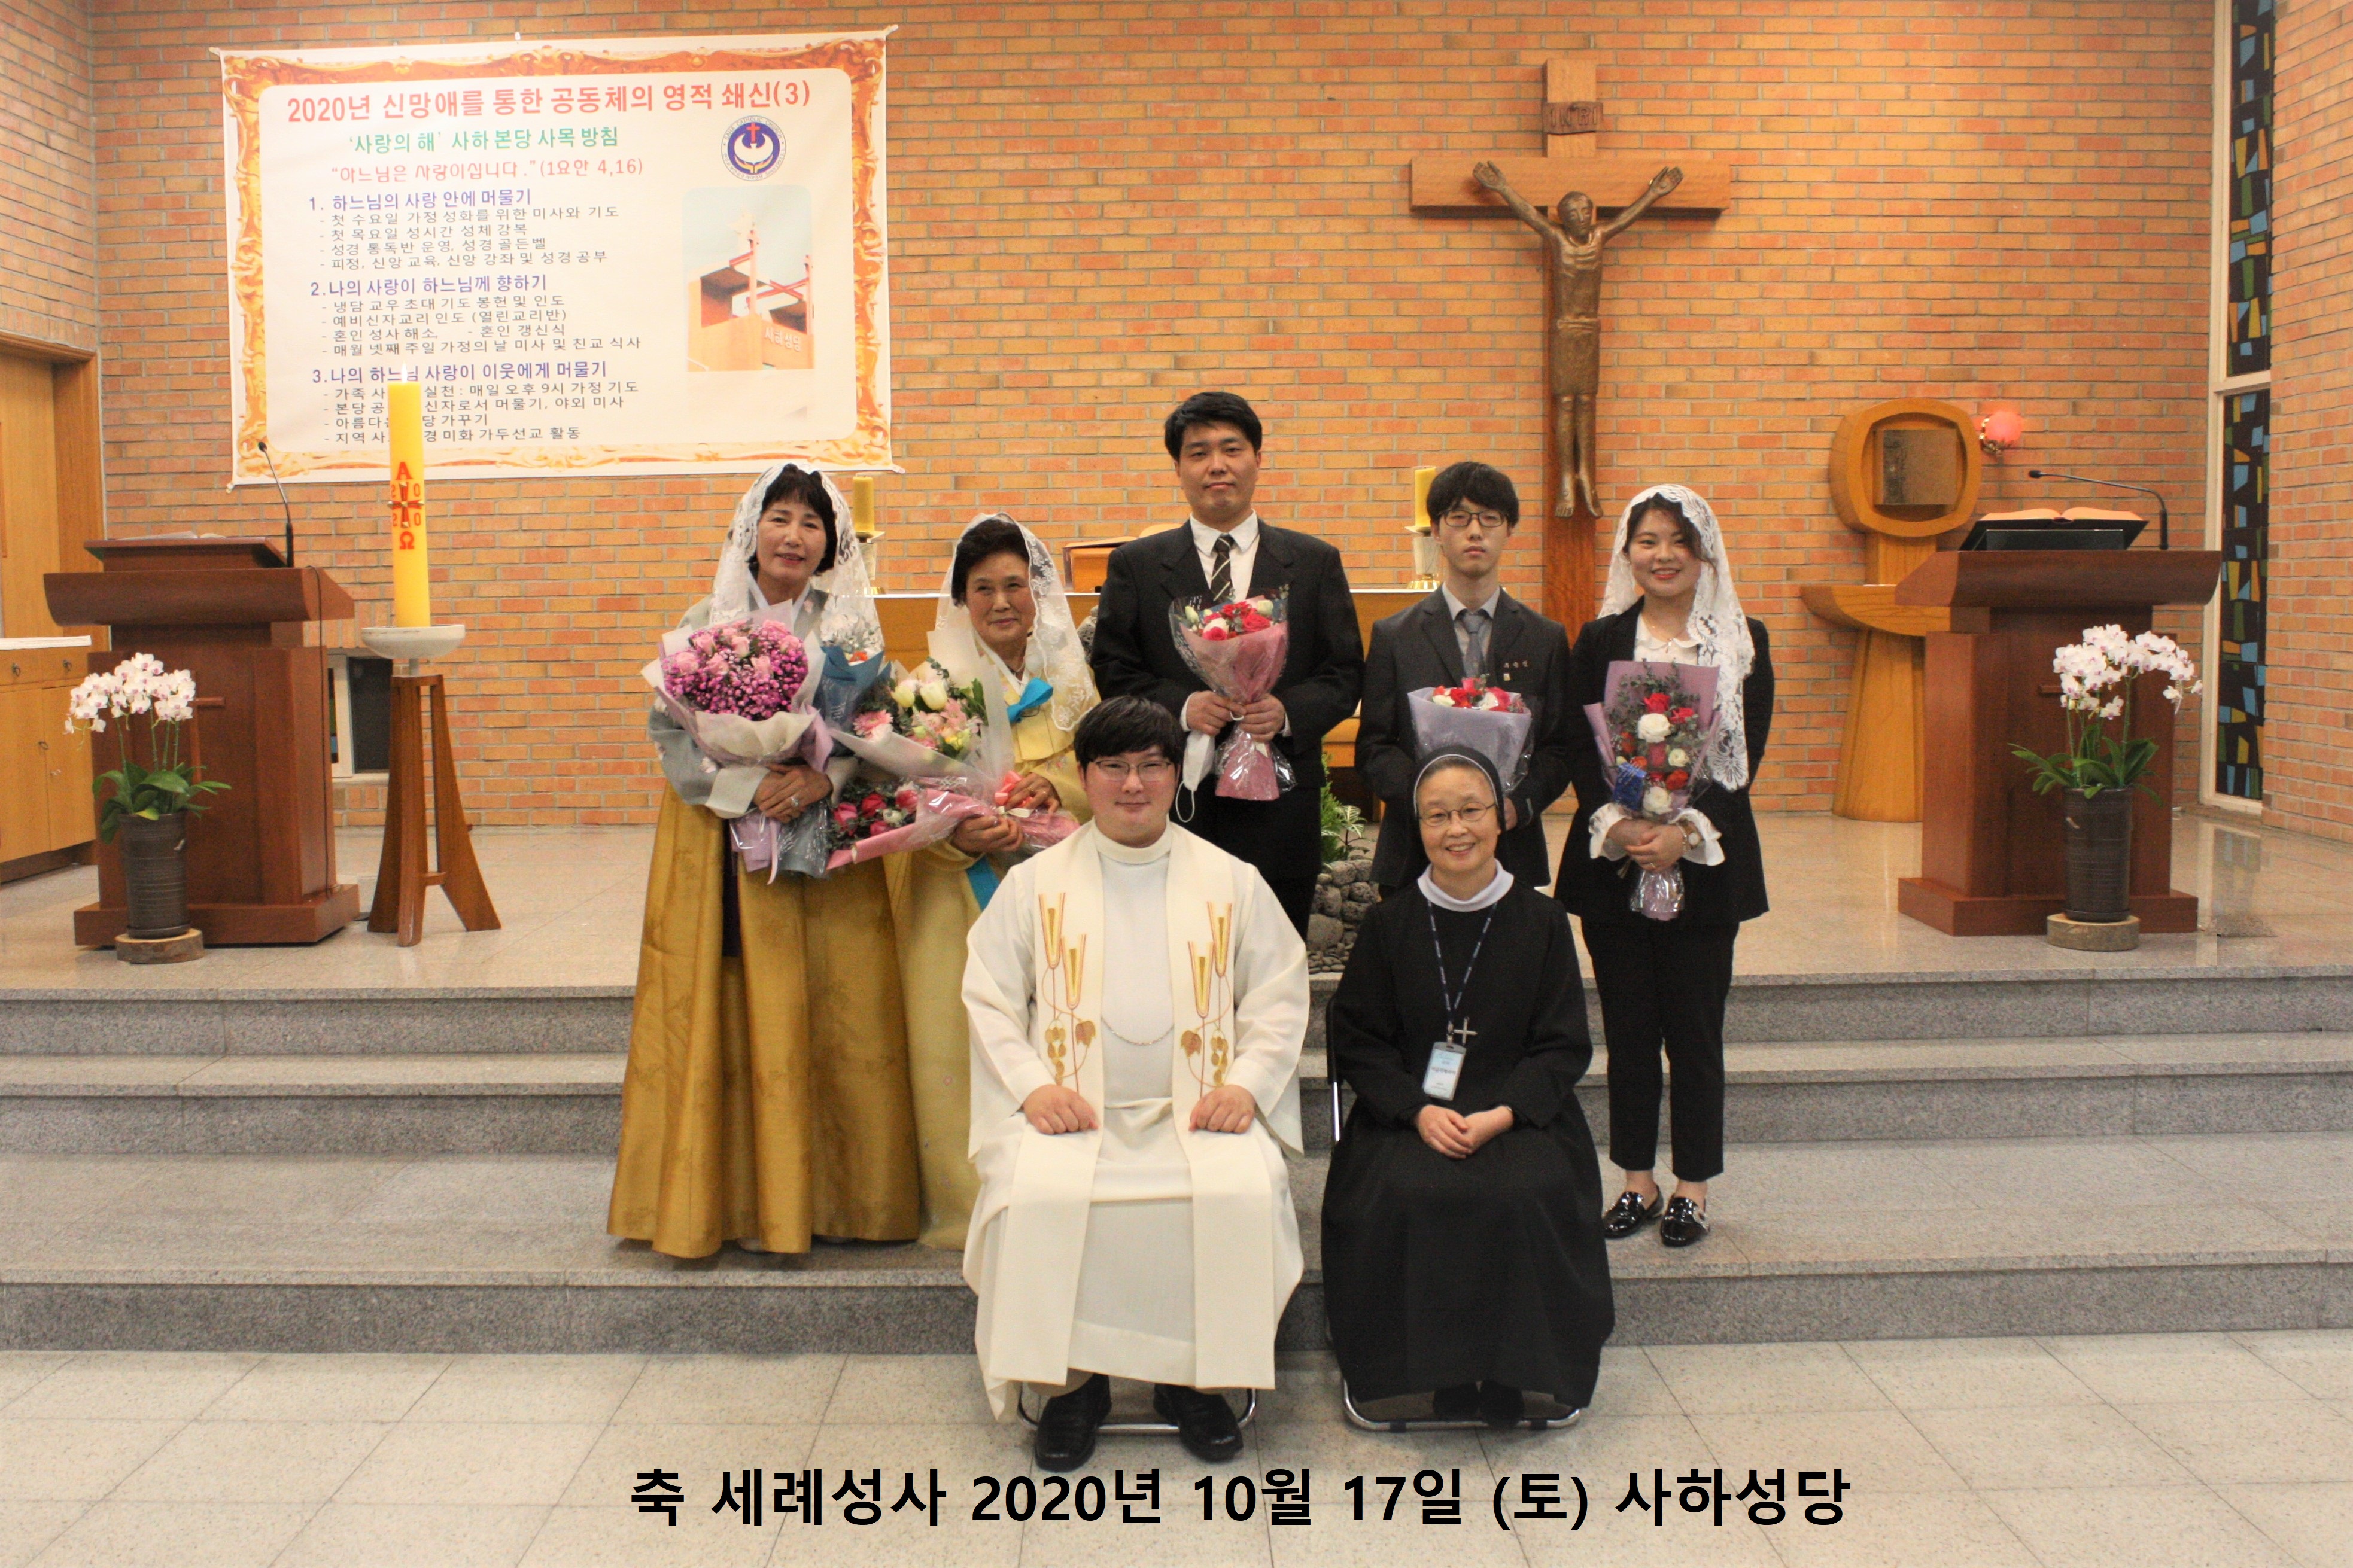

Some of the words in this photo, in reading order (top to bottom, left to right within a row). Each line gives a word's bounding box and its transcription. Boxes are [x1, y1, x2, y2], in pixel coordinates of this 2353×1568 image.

[288, 95, 370, 123] 2020년
[383, 90, 484, 118] 신망애를
[493, 87, 543, 115] 통한
[551, 85, 653, 114] 공동체의
[663, 83, 712, 111] 영적
[721, 80, 810, 109] 쇄신(3)
[1551, 107, 1597, 126] INRI
[451, 130, 489, 151] 사하
[494, 129, 531, 149] 본당
[538, 127, 575, 148] 사목
[581, 127, 618, 147] 방침
[309, 197, 324, 211] 1.
[333, 193, 399, 211] 하느님의
[405, 192, 437, 209] 사랑
[443, 190, 475, 208] 안에
[481, 188, 531, 206] 머물기
[332, 214, 345, 227] 첫
[352, 212, 397, 226] 수요일
[407, 211, 437, 224] 가정
[443, 209, 490, 223] 성화를
[495, 208, 527, 221] 위한
[533, 206, 580, 220] 미사와
[588, 206, 619, 218] 기도
[332, 229, 345, 242] 첫
[352, 227, 397, 240] 목요일
[407, 226, 453, 239] 성시간
[461, 224, 491, 238] 성체
[497, 224, 527, 236] 강복
[332, 243, 359, 256] 성경
[367, 242, 415, 255] 통독반
[462, 239, 492, 252] 성경
[498, 238, 545, 250] 골든벨
[372, 256, 402, 269] 신앙
[448, 254, 476, 267] 신앙
[484, 252, 515, 266] 강좌
[520, 252, 533, 264] 및
[541, 251, 570, 264] 성경
[576, 250, 607, 263] 공부
[366, 278, 415, 296] 사랑이
[422, 275, 490, 294] 하느님께
[497, 274, 546, 292] 향하기
[334, 300, 364, 313] 냉담
[369, 299, 399, 312] 교우
[405, 298, 435, 310] 초대
[440, 297, 470, 309] 기도
[476, 296, 507, 309] 봉헌
[513, 296, 526, 307] 및
[534, 295, 564, 307] 인도
[435, 312, 465, 324] 인도
[472, 309, 566, 324] (열린교리반)
[333, 330, 362, 342] 혼인
[369, 328, 400, 341] 성사
[480, 325, 509, 338] 혼인
[518, 324, 564, 337] 갱신식
[765, 327, 801, 352] 사하성당
[334, 344, 362, 357] 매월
[369, 343, 400, 355] 넷째
[405, 342, 434, 355] 주일
[440, 340, 487, 354] 가정의
[494, 340, 507, 352] 날
[515, 339, 545, 351] 미사
[552, 338, 566, 351] 및
[573, 337, 603, 350] 친교
[610, 337, 641, 349] 식사
[370, 366, 418, 383] 하느님
[425, 364, 475, 382] 사랑이
[483, 362, 549, 380] 이웃에게
[557, 361, 606, 378] 머물기
[335, 388, 366, 400] 가족
[469, 384, 499, 396] 매일
[505, 383, 536, 395] 오후
[541, 382, 564, 394] 9시
[571, 382, 601, 394] 가정
[608, 381, 639, 394] 기도
[335, 403, 366, 415] 본당
[425, 400, 488, 412] 신자로서
[555, 397, 585, 409] 야외
[593, 396, 624, 408] 미사
[442, 413, 487, 427] 가꾸기
[336, 432, 365, 444] 지역
[443, 428, 473, 442] 미화
[479, 427, 543, 440] 가두선교
[549, 427, 580, 439] 활동
[399, 531, 415, 550] Ω
